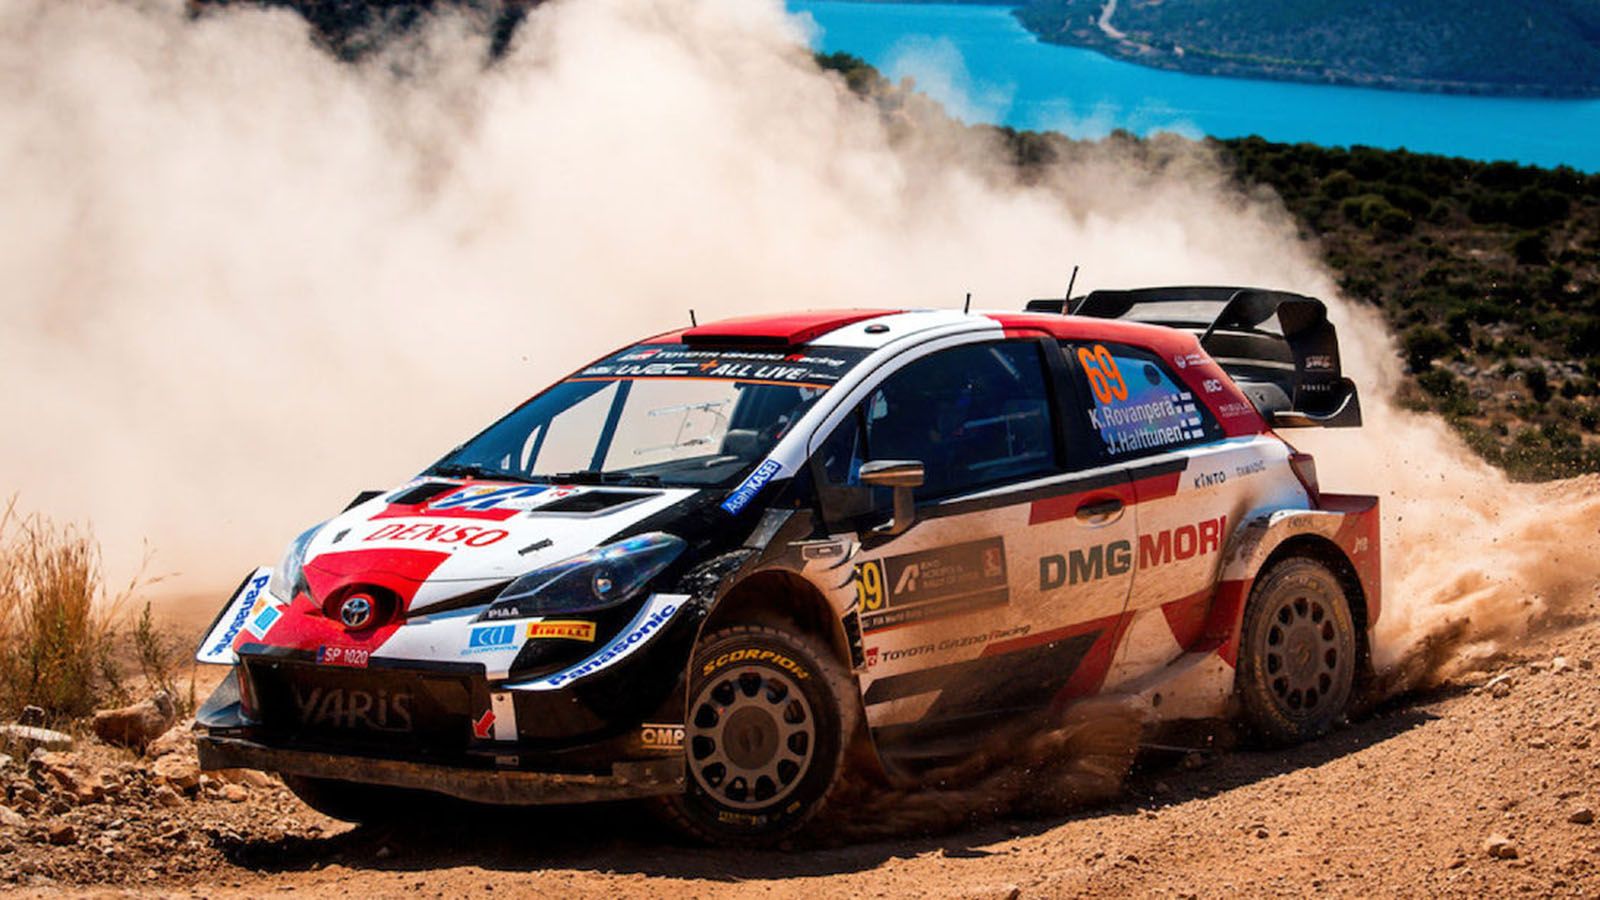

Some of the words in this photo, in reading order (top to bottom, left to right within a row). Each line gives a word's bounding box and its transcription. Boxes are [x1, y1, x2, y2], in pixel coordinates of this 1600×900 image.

[709, 363, 752, 376] ALL
[754, 366, 807, 379] LIVE
[1077, 344, 1128, 405] 69
[1088, 397, 1176, 429] K.Rovanperä
[1107, 425, 1184, 456] J.Halttunen
[362, 523, 510, 548] DENSO
[1039, 539, 1132, 592] DMG
[1138, 514, 1227, 571] MORI
[207, 574, 270, 657] Panasonic
[488, 607, 519, 618] PIAA
[530, 623, 592, 638] PIRELLI
[547, 603, 676, 686] Panasonic
[882, 644, 935, 662] TOYOTA
[988, 624, 1032, 642] Racing
[324, 647, 341, 662] SP
[343, 649, 369, 664] 1020
[702, 648, 811, 681] SCORPION
[641, 728, 685, 746] OMP
